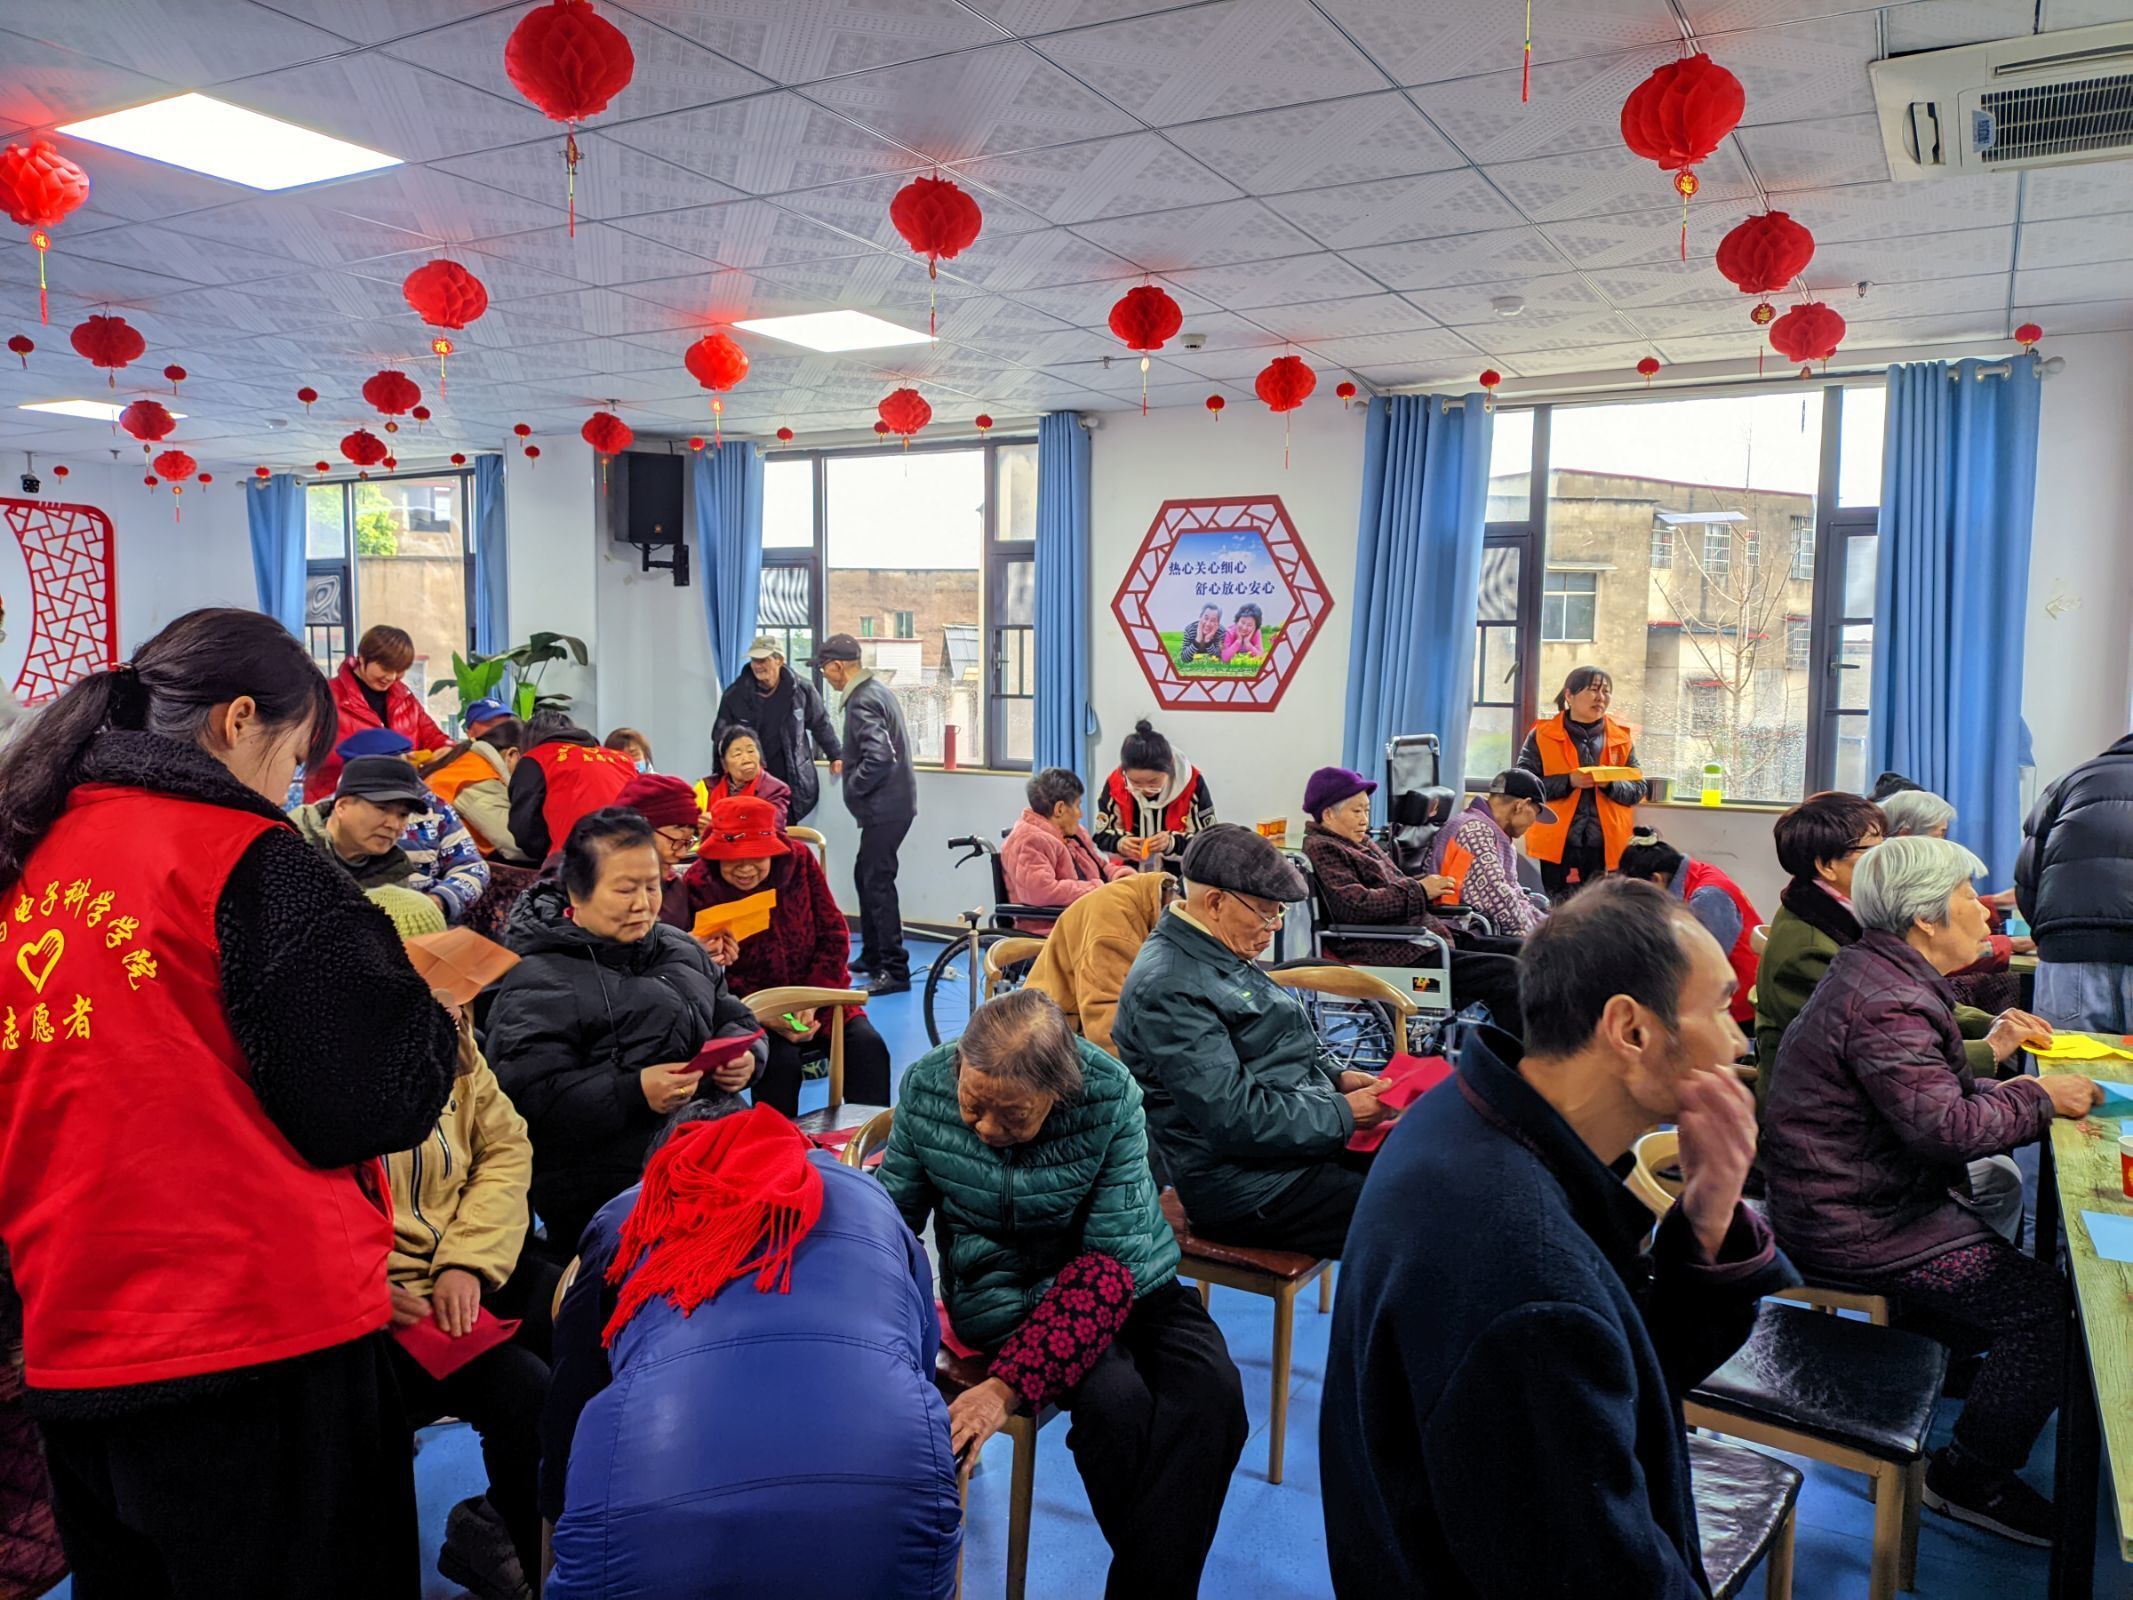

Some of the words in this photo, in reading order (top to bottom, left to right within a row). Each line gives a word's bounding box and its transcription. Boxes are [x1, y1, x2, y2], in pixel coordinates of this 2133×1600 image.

[1169, 560, 1247, 576] 热心关心细心
[1195, 580, 1275, 596] 舒心放心安心
[2, 993, 93, 1050] 志愿者
